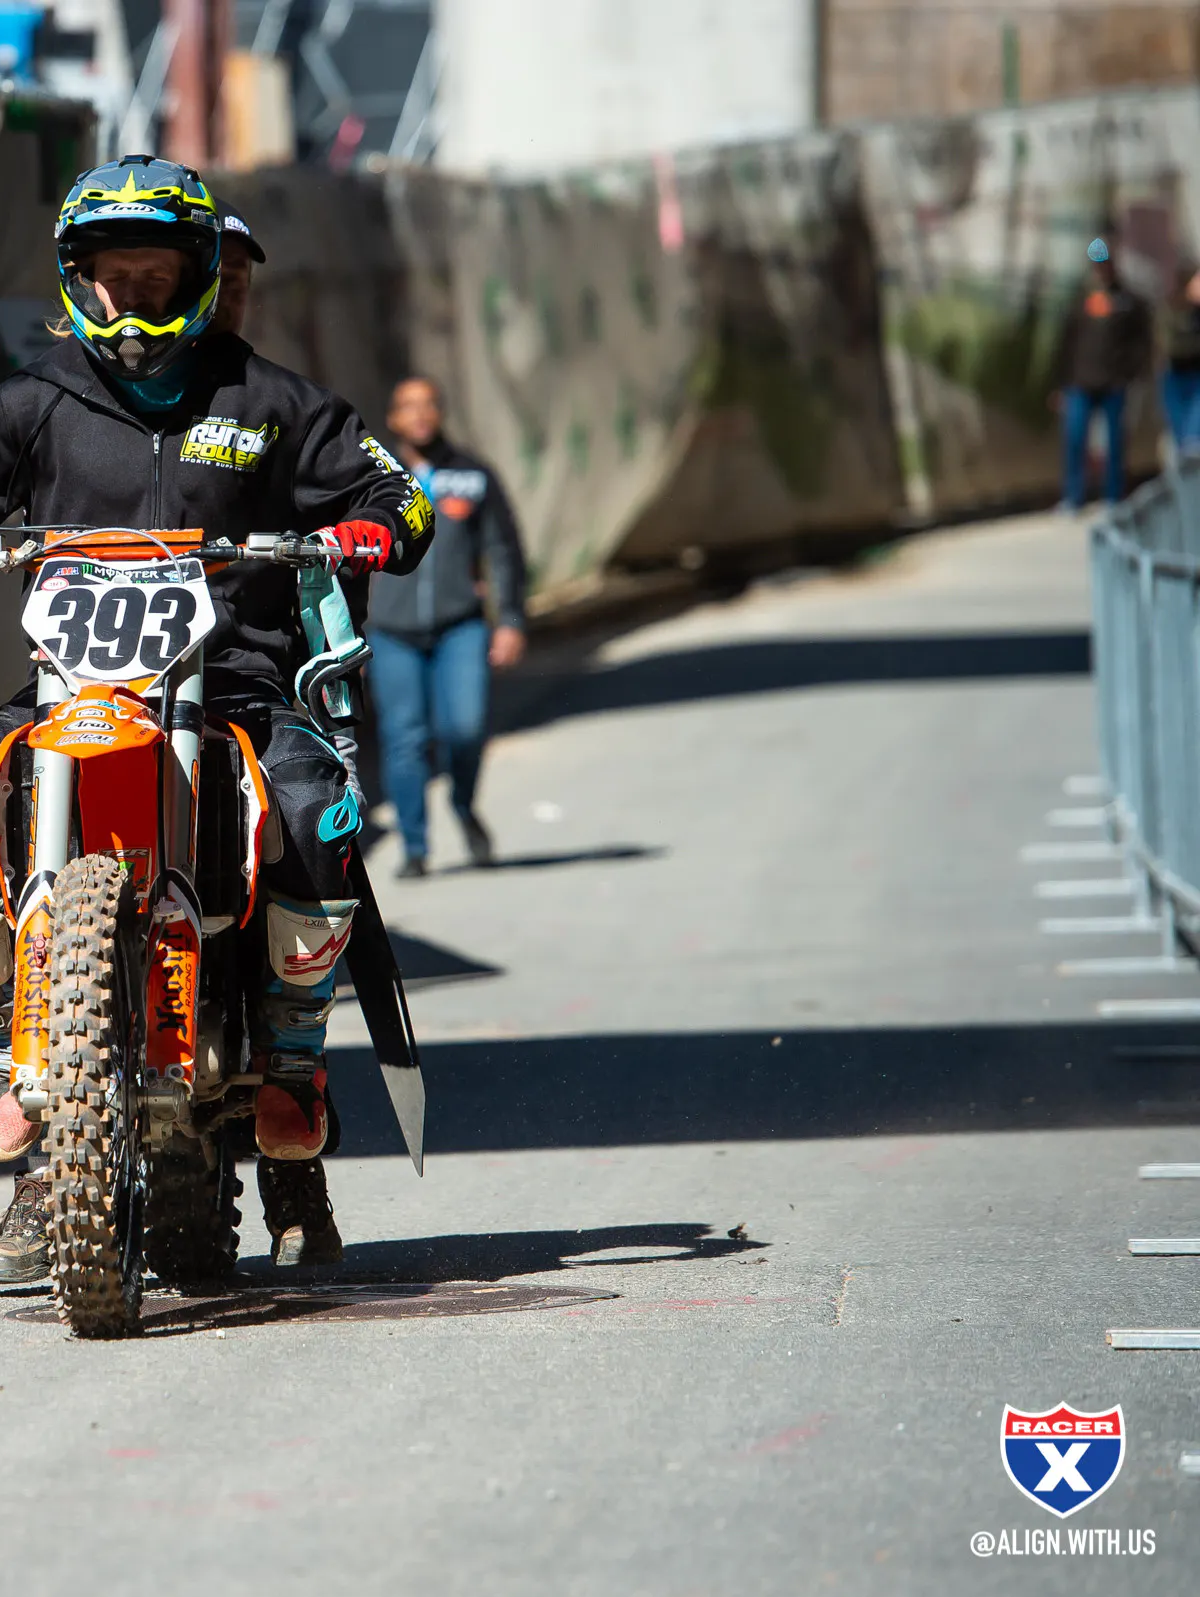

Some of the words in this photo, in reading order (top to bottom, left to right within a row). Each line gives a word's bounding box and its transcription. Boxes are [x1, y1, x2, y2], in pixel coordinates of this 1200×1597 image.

[187, 423, 258, 453] RYNO
[180, 457, 211, 466] SPORTS
[183, 441, 260, 468] POWER
[42, 586, 197, 671] 393
[304, 918, 326, 928] LXIII
[184, 963, 193, 1008] RACING
